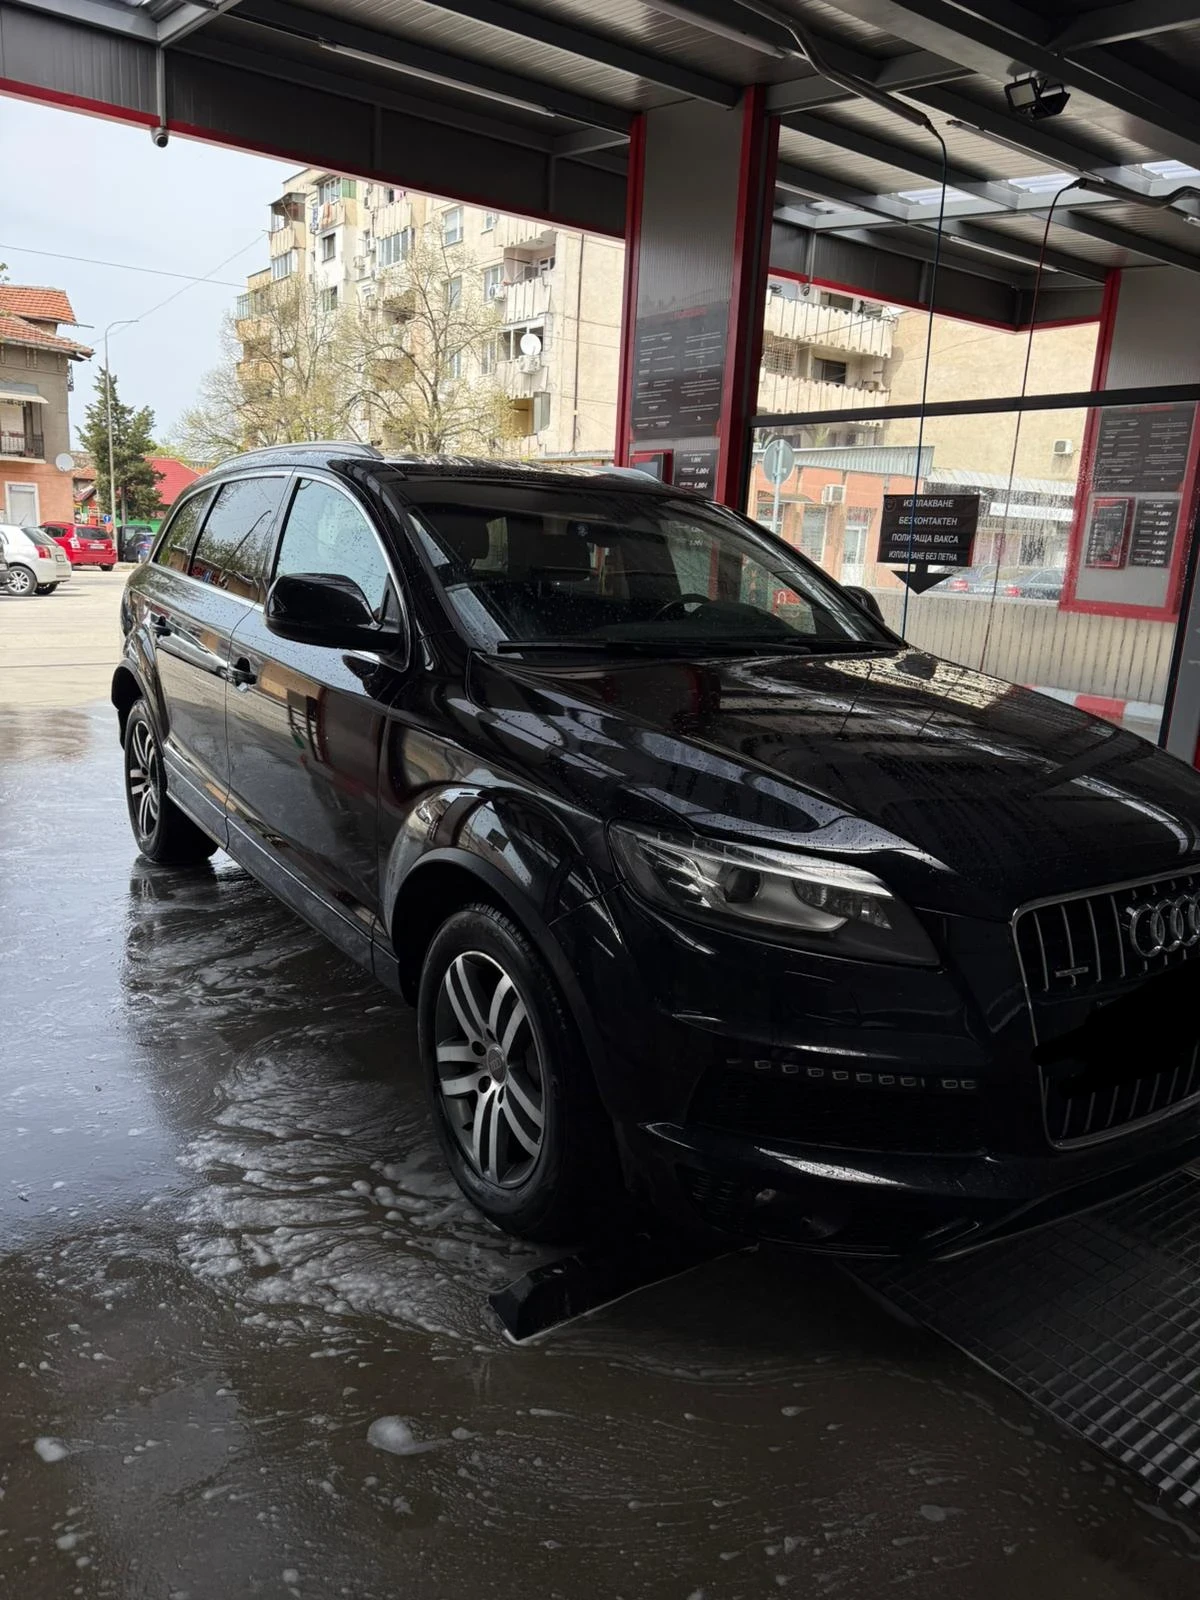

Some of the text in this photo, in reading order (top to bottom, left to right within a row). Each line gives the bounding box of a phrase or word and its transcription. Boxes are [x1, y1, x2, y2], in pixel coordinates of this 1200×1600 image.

[933, 534, 959, 544] ВАКСА
[925, 552, 937, 560] БЕЗ
[938, 552, 957, 561] ПЕТНА
